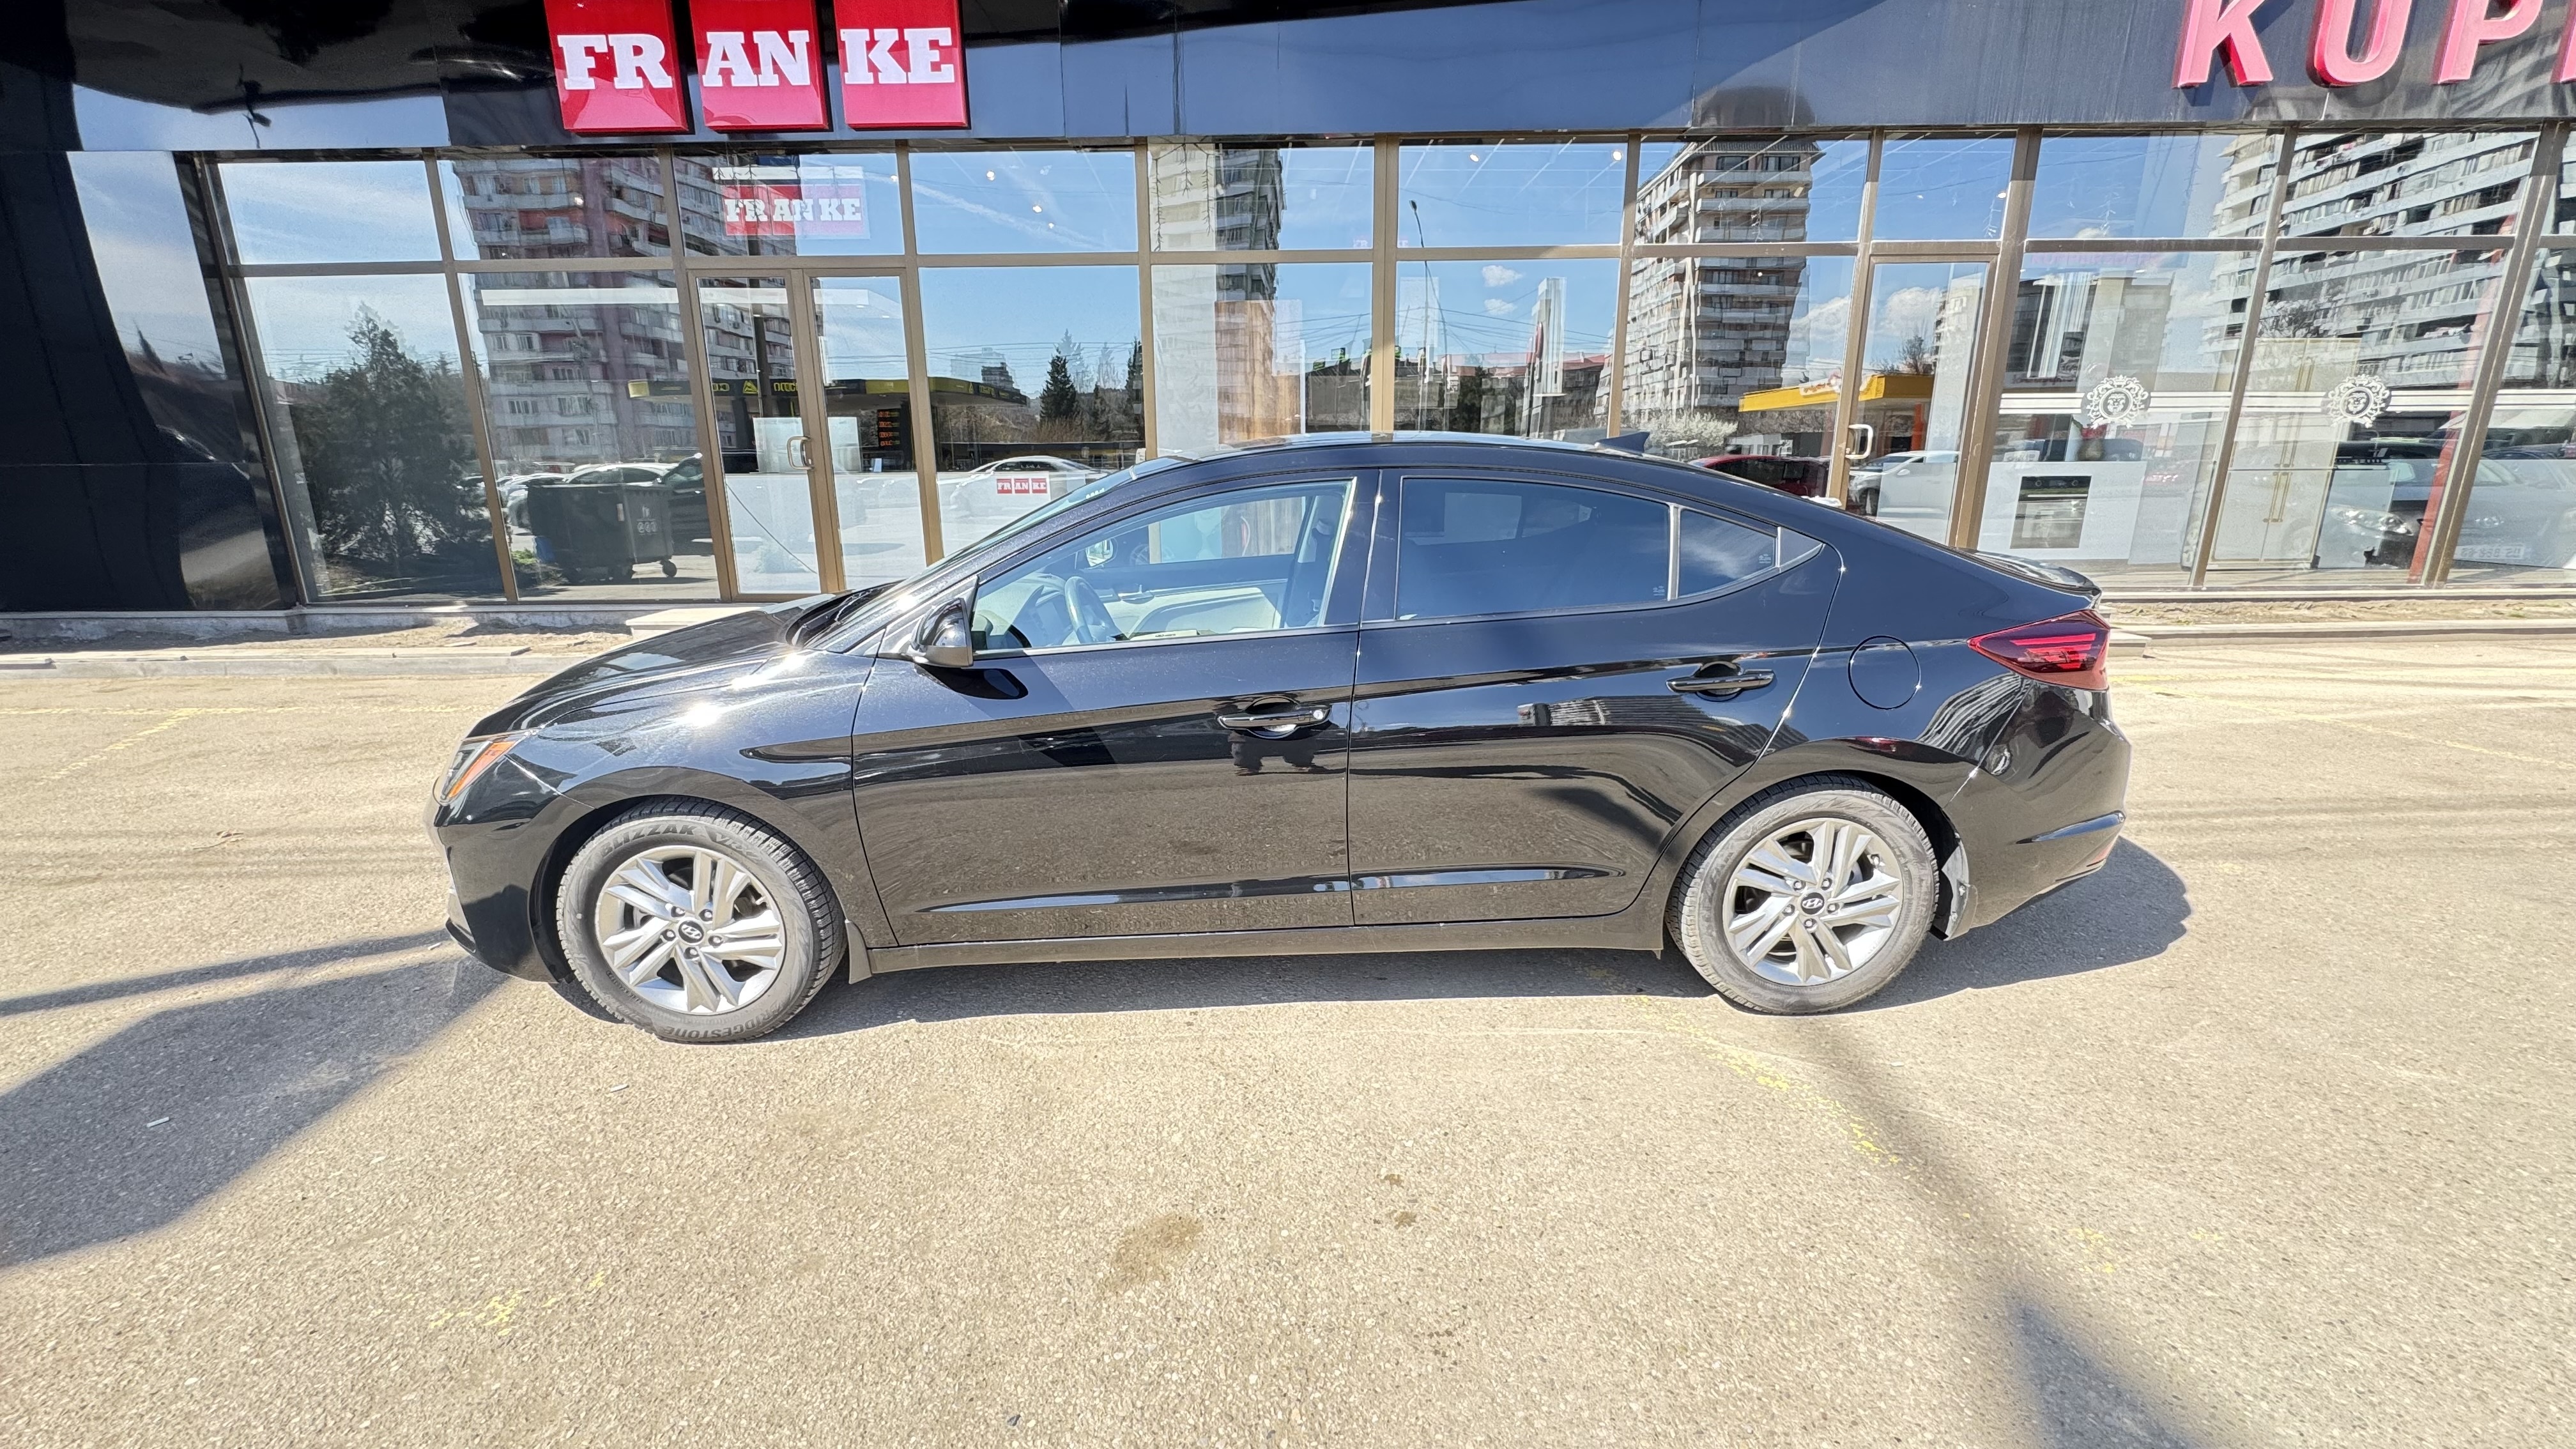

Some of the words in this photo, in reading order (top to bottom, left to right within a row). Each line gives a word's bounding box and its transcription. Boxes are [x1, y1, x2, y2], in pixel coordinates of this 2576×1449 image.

[2175, 0, 2576, 86] KUP
[724, 198, 862, 222] FRANKE
[997, 482, 1046, 490] FRANKE
[601, 824, 694, 858] BLIZZAK
[664, 1003, 781, 1039] BRIDGESTONE
